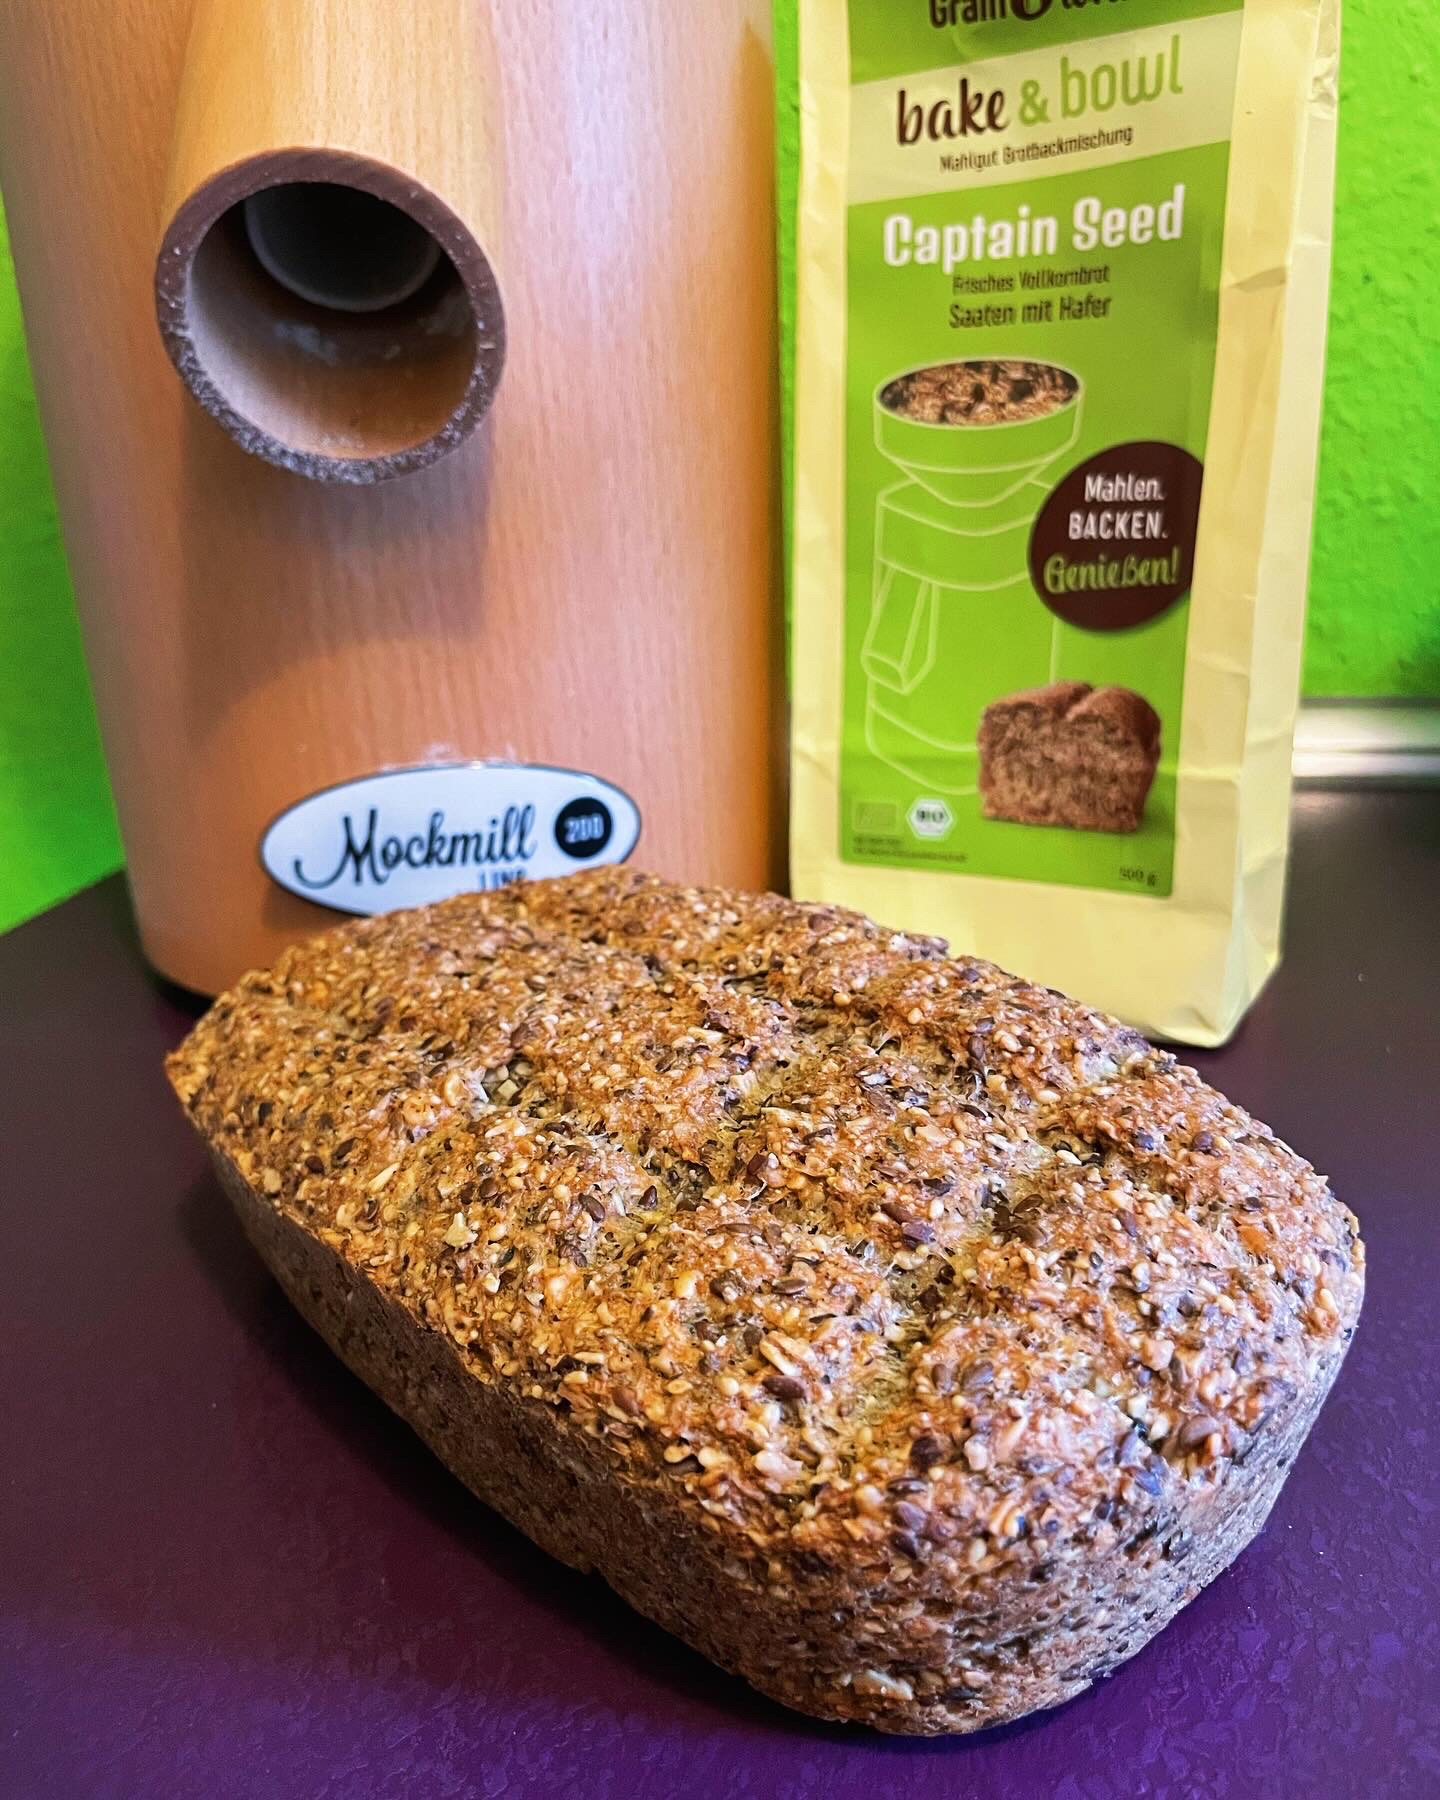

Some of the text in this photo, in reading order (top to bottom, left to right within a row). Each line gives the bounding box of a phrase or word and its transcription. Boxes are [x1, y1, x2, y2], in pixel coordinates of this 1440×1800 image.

[896, 35, 1184, 146] bake & bowl
[883, 183, 1186, 274] Captain Seed
[949, 294, 1112, 328] Saaten mit Hafer
[1084, 473, 1166, 502] Mahlen.
[1068, 511, 1169, 540] BACKEN.
[1043, 546, 1181, 594] Genießen!
[294, 804, 538, 889] Mockmill
